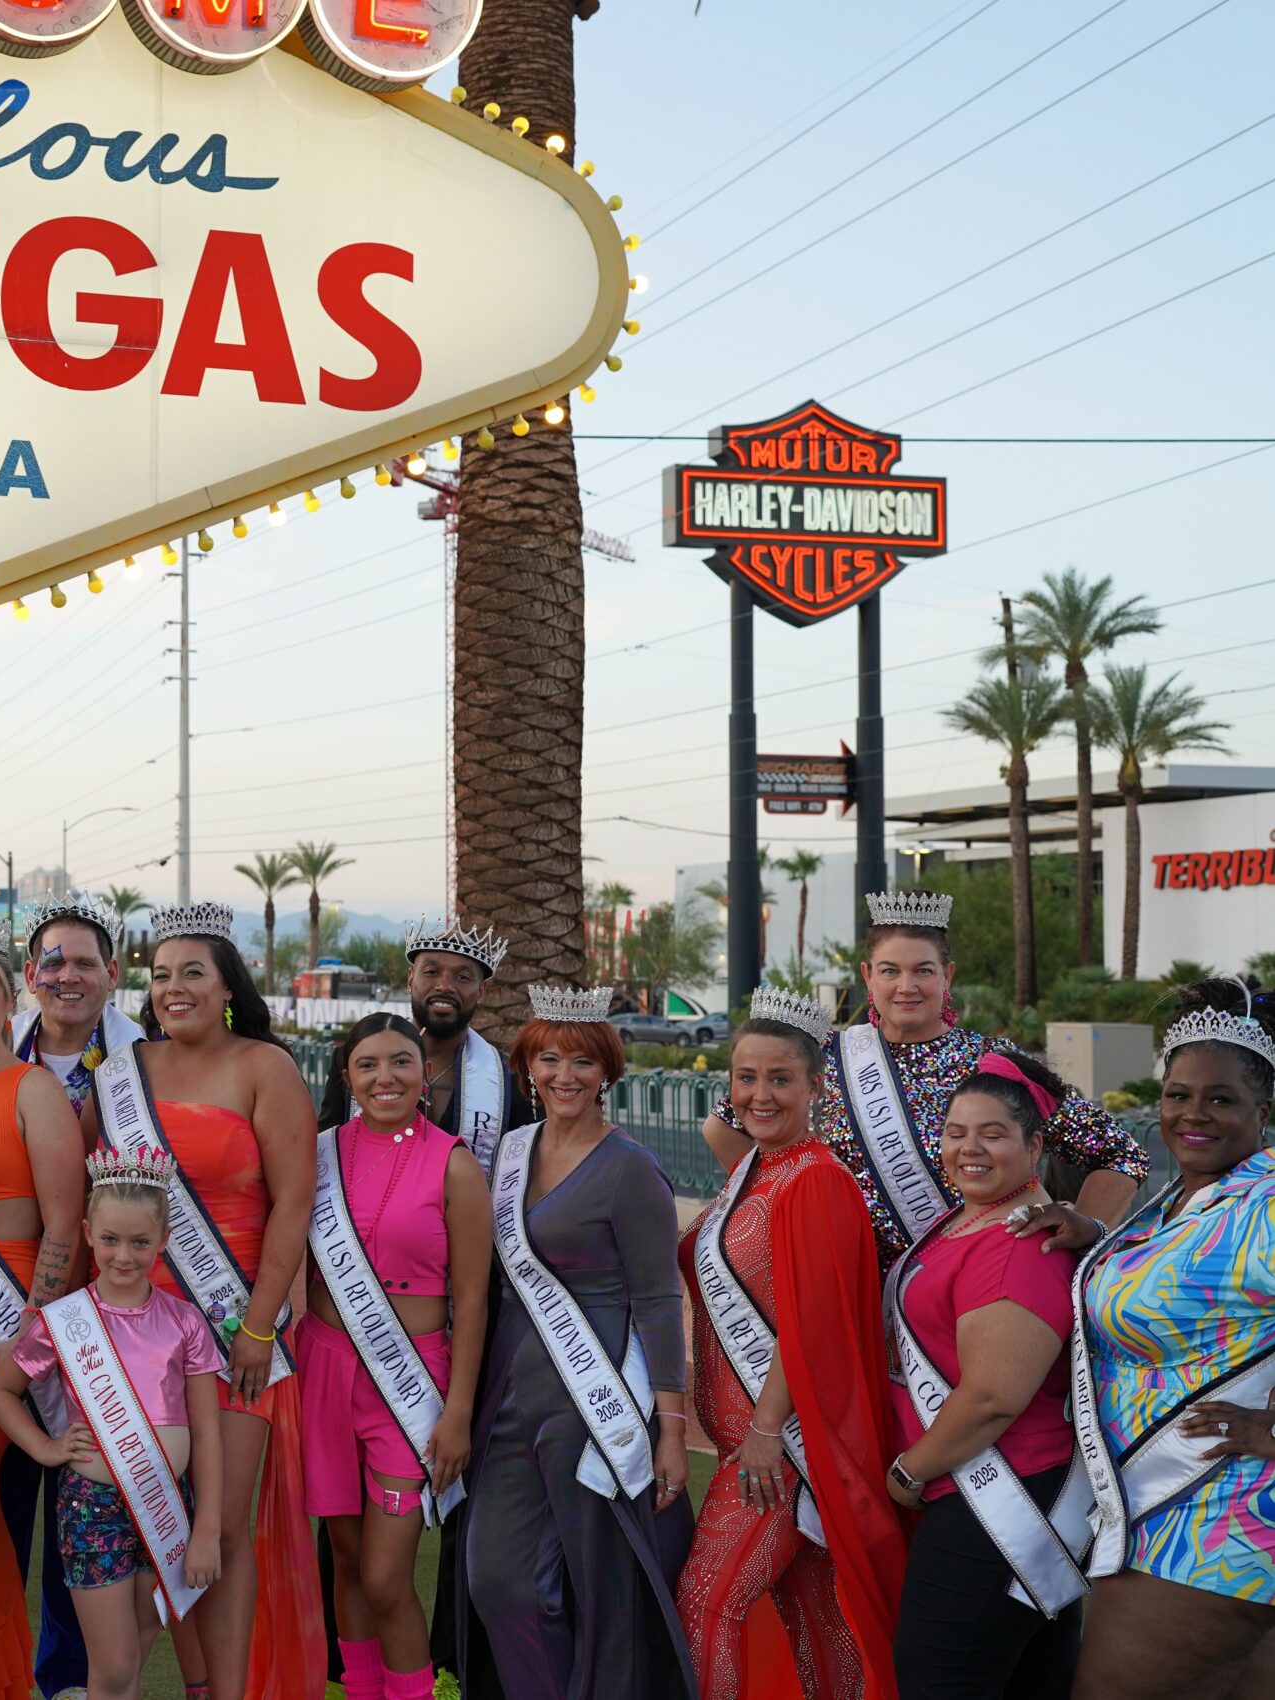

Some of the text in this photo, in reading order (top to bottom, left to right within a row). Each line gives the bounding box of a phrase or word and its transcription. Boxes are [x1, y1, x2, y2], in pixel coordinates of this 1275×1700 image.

[751, 420, 876, 472] MOTOR
[694, 481, 932, 536] HARLEY-DAVIDSON
[751, 546, 876, 603] CYCLES
[856, 1062, 883, 1095] MRS
[866, 1097, 893, 1129] USA
[496, 1168, 600, 1377] MS AMERICA REVOLUTIONARY
[696, 1246, 736, 1318] AMERICA
[209, 1282, 235, 1304] 2024
[311, 1196, 429, 1409] TEEN USA REVOLUTIONARY
[75, 1341, 100, 1366] Mini
[82, 1356, 104, 1376] Miss
[587, 1385, 613, 1406] Elite
[595, 1400, 624, 1424] 2025
[1076, 1368, 1098, 1461] DIRECTOR
[89, 1374, 179, 1542] CANADA REVOLUTIONARY
[970, 1463, 999, 1491] 2025
[165, 1539, 186, 1567] 2025
